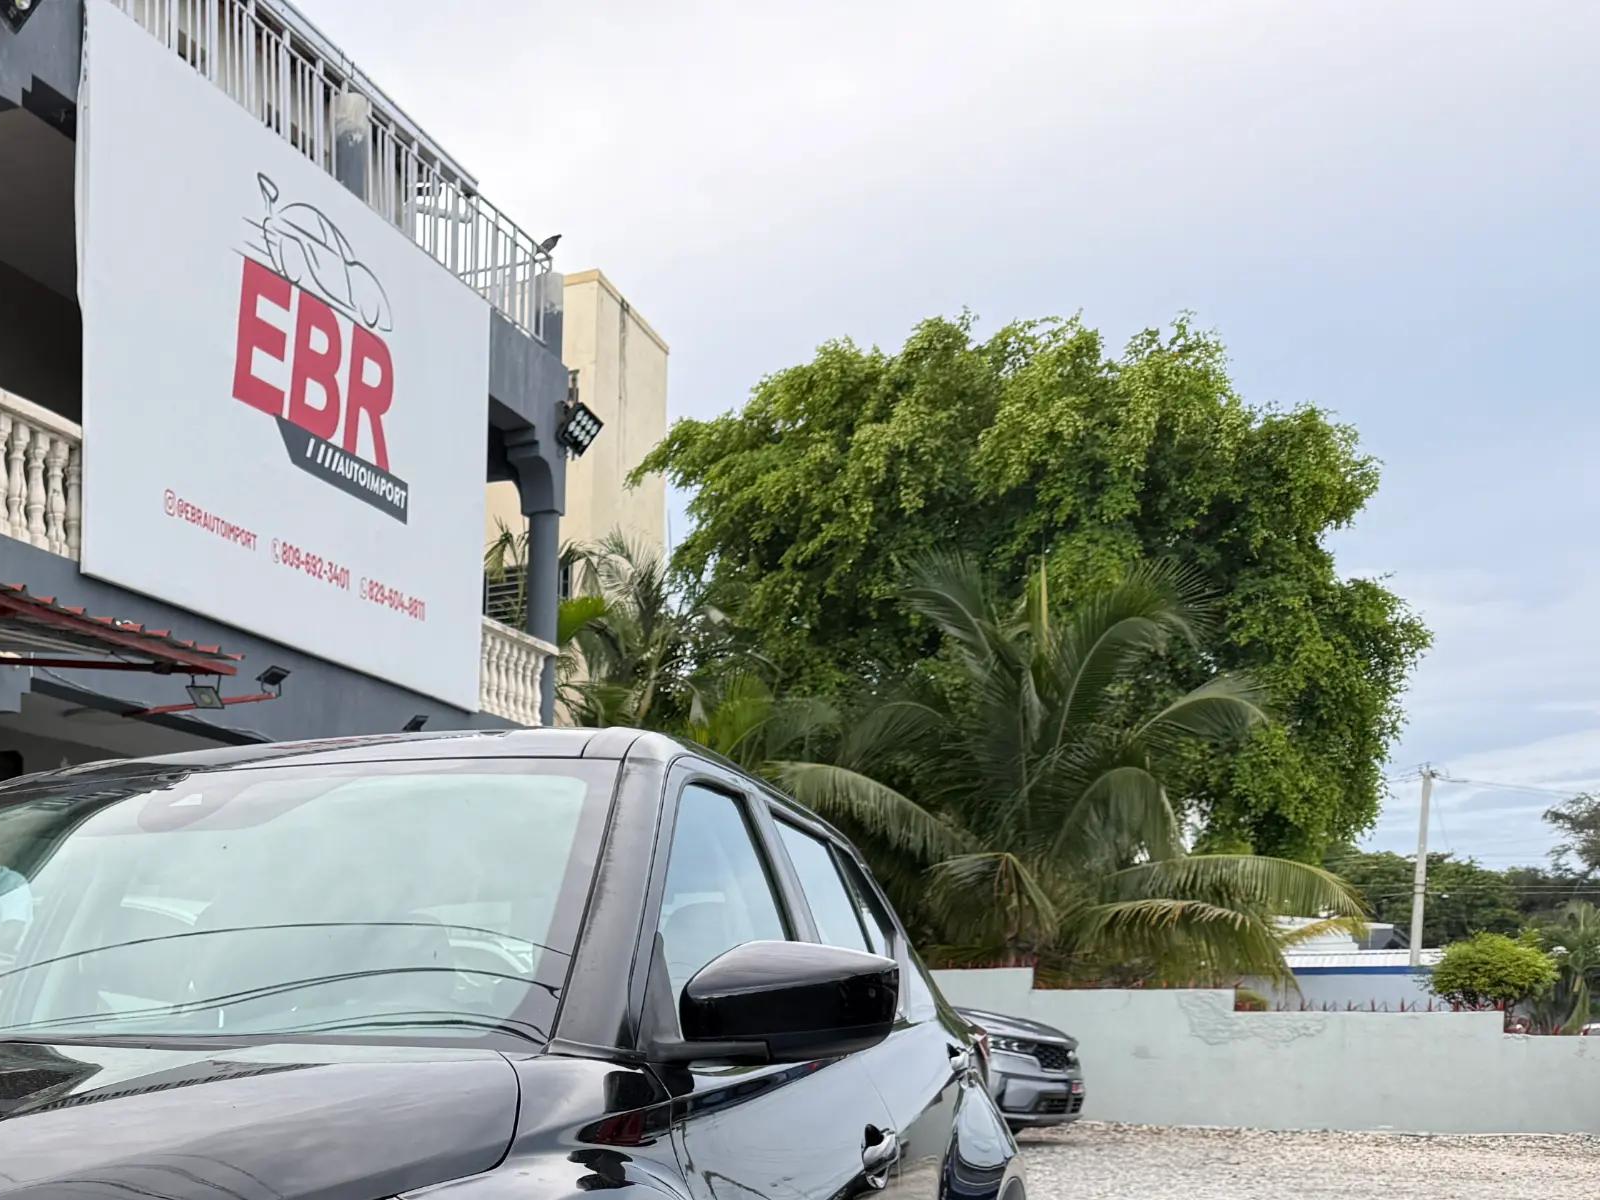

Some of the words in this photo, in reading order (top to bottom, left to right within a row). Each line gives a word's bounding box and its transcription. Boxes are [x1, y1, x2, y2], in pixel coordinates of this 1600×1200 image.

[232, 256, 394, 473] EBR
[337, 455, 407, 509] AUTOIMPORT
[177, 498, 258, 551] @EBRAUTOIMPORT
